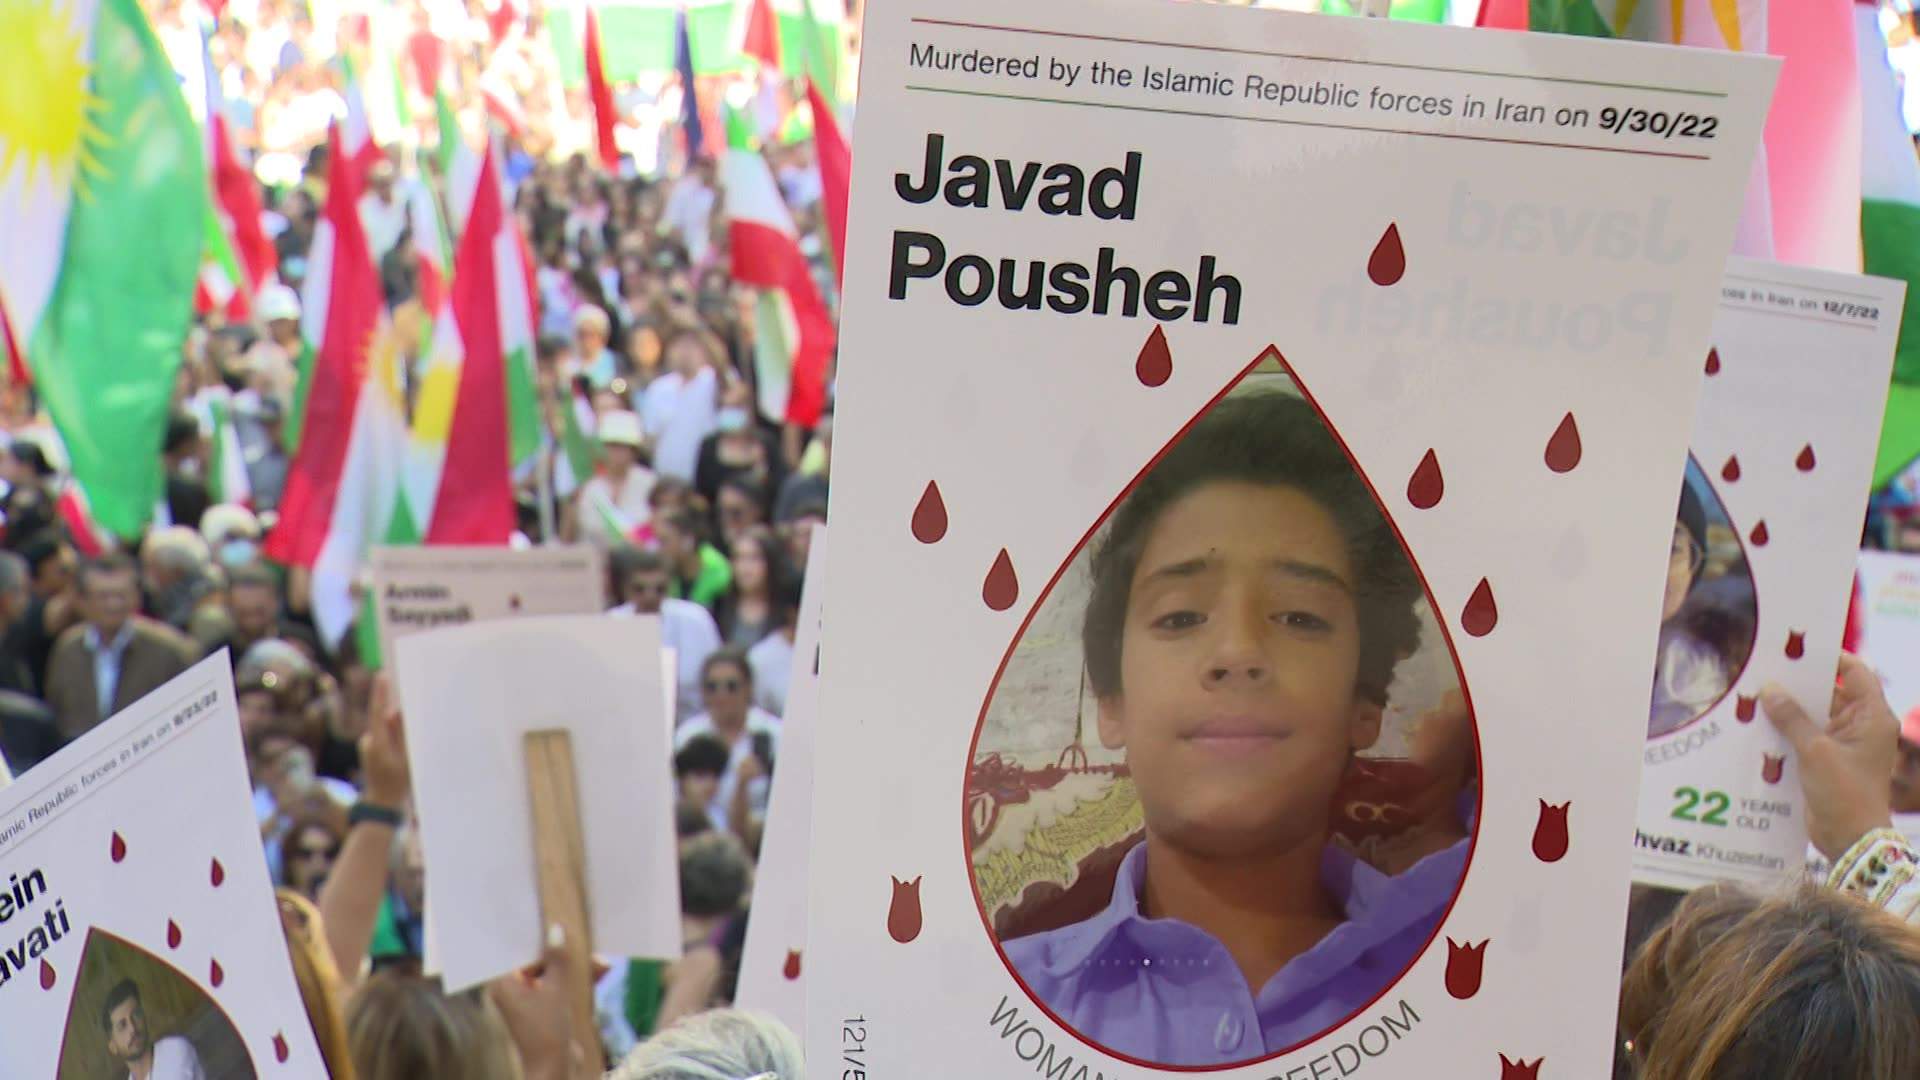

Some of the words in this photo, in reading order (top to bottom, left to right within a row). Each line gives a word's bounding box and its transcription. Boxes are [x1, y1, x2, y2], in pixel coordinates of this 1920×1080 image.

[909, 43, 1040, 79] Murdered
[1049, 57, 1081, 87] by
[1091, 61, 1132, 87] the
[1143, 65, 1234, 97] Islamic
[1244, 75, 1359, 111] Republic
[1369, 86, 1453, 117] forces
[1462, 94, 1485, 119] in
[1494, 97, 1545, 124] Iran
[1555, 105, 1589, 128] on
[1598, 106, 1719, 139] 9/30/22
[894, 132, 1142, 221] Javad
[888, 229, 1243, 326] Pousheh
[1768, 291, 1795, 307] Iran
[1800, 298, 1818, 311] on
[28, 782, 79, 823] Republic
[81, 757, 118, 788] forces
[1670, 785, 1731, 827] 22
[1741, 798, 1792, 817] YEARS
[1736, 815, 1771, 831] OLD
[1696, 842, 1785, 870] Khuzestan
